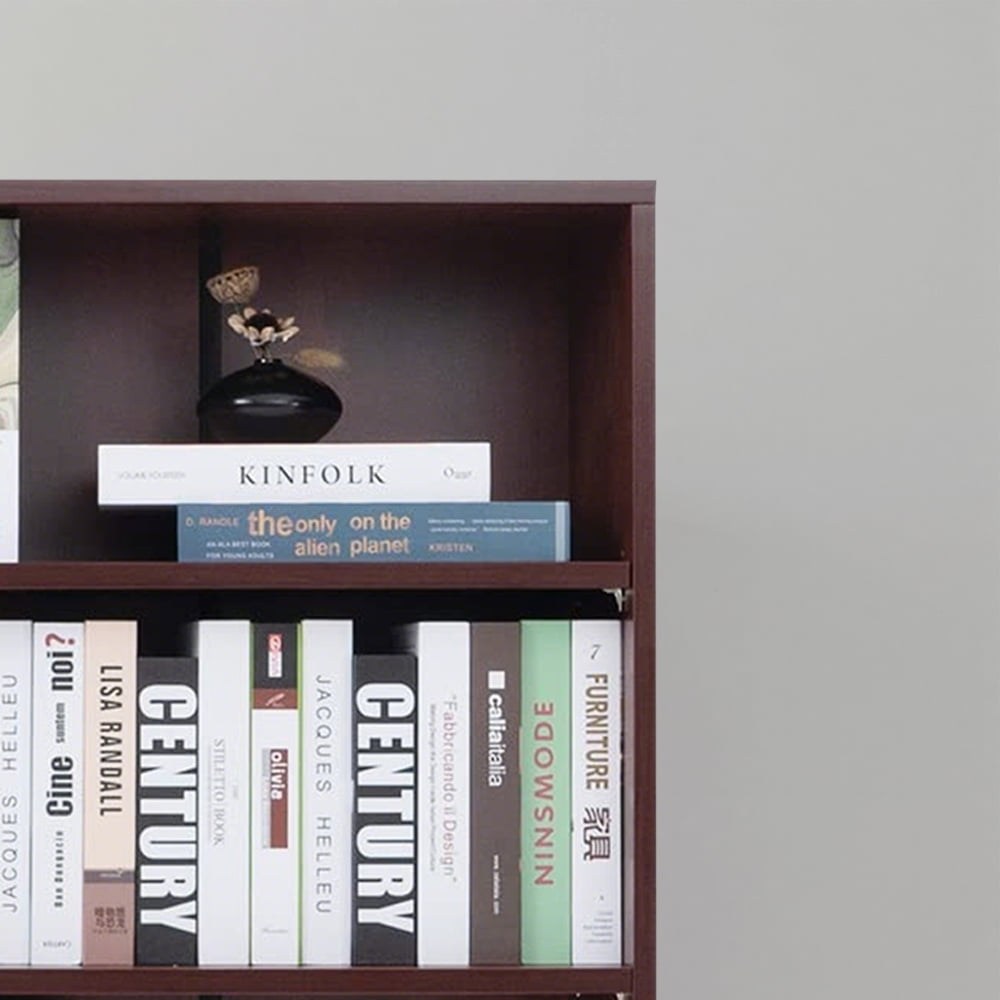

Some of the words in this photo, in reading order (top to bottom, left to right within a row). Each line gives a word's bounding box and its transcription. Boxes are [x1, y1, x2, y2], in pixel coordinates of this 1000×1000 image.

[241, 465, 384, 484] KINFOLK
[247, 510, 294, 536] the
[295, 513, 337, 536] only
[351, 515, 377, 530] on
[379, 512, 411, 530] the
[295, 535, 340, 556] alien
[350, 536, 409, 557] planet
[429, 543, 475, 552] KRISTEN
[591, 644, 601, 660] 7
[100, 666, 122, 710] LISA
[2, 675, 17, 770] HELLEU
[55, 702, 65, 743] suntem
[316, 675, 332, 792] JACQUES
[586, 674, 608, 789] FURNITURE
[46, 756, 74, 817] Cine
[100, 722, 122, 816] RANDALL
[213, 738, 225, 803] STILETTO
[271, 752, 283, 800] olivia
[534, 703, 554, 885] NINSMODE
[139, 682, 199, 936] CENTURY
[212, 805, 225, 847] BOOK
[354, 683, 415, 933] CENTURY
[445, 806, 456, 815] il
[583, 808, 611, 860] 家具
[2, 796, 17, 912] JACQUES
[316, 817, 332, 912] HELLEU
